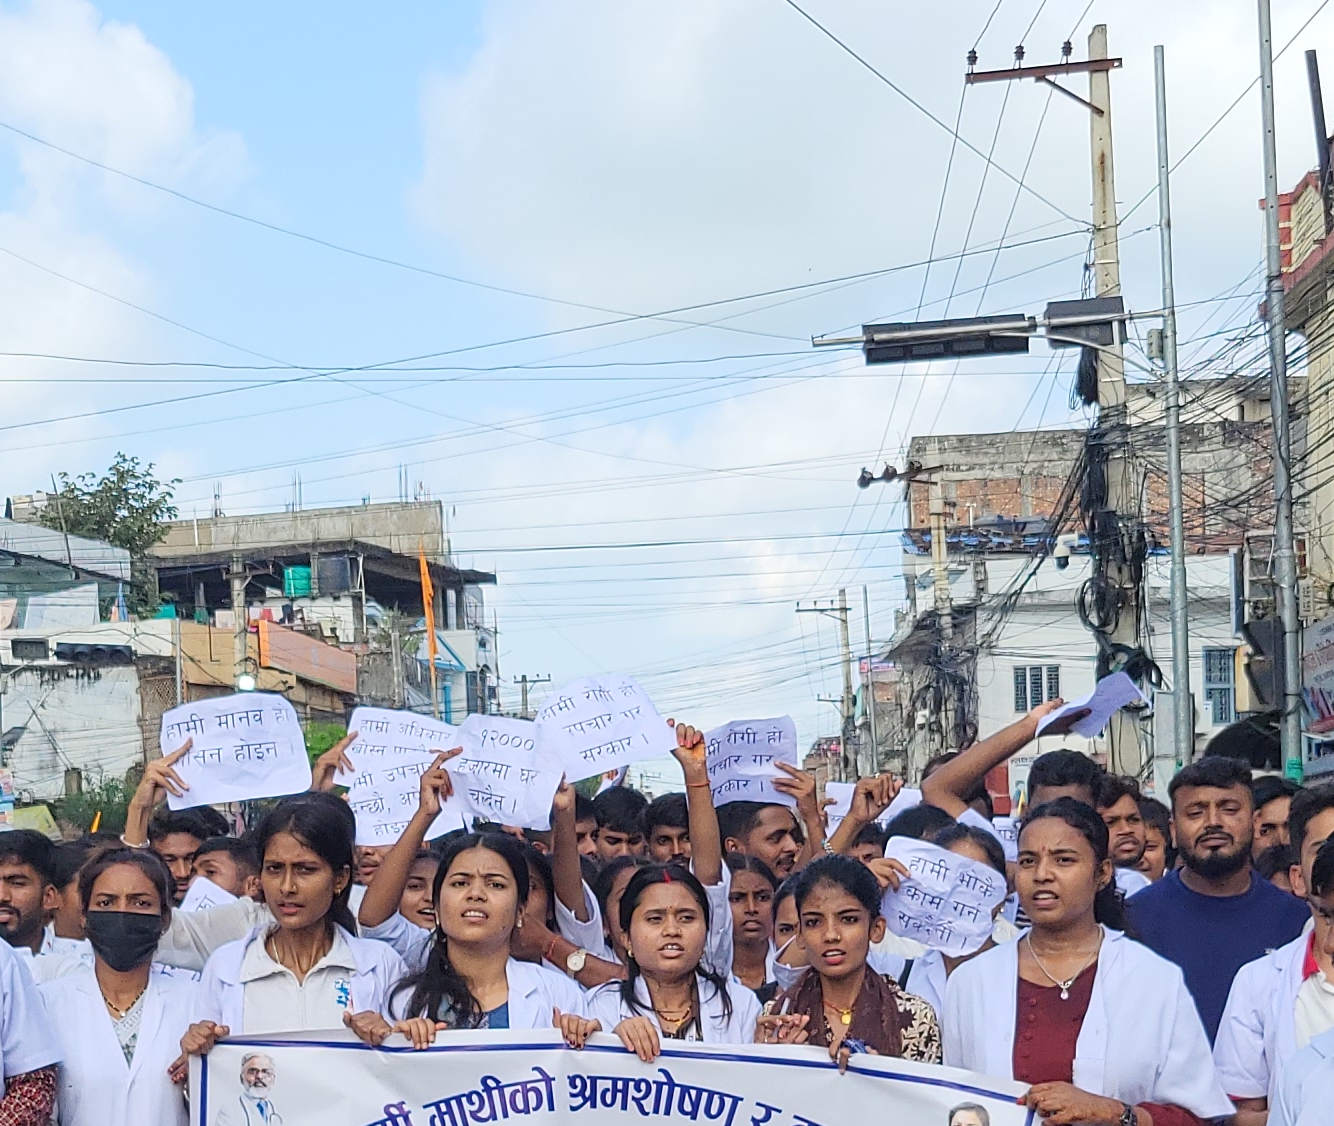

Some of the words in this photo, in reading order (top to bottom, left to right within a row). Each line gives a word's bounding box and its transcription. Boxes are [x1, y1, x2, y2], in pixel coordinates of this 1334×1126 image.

[167, 713, 205, 741] हामी
[215, 709, 264, 730] मानव
[726, 727, 758, 745] रोगी
[766, 726, 784, 745] हो
[233, 738, 278, 762] होइन
[481, 729, 534, 751] १२०००
[579, 736, 634, 763] सरकार
[382, 762, 431, 782] उपचा
[520, 768, 540, 785] घर
[708, 754, 743, 777] पचार
[752, 754, 775, 768] गर
[908, 855, 950, 883] हामी
[906, 885, 945, 911] काम
